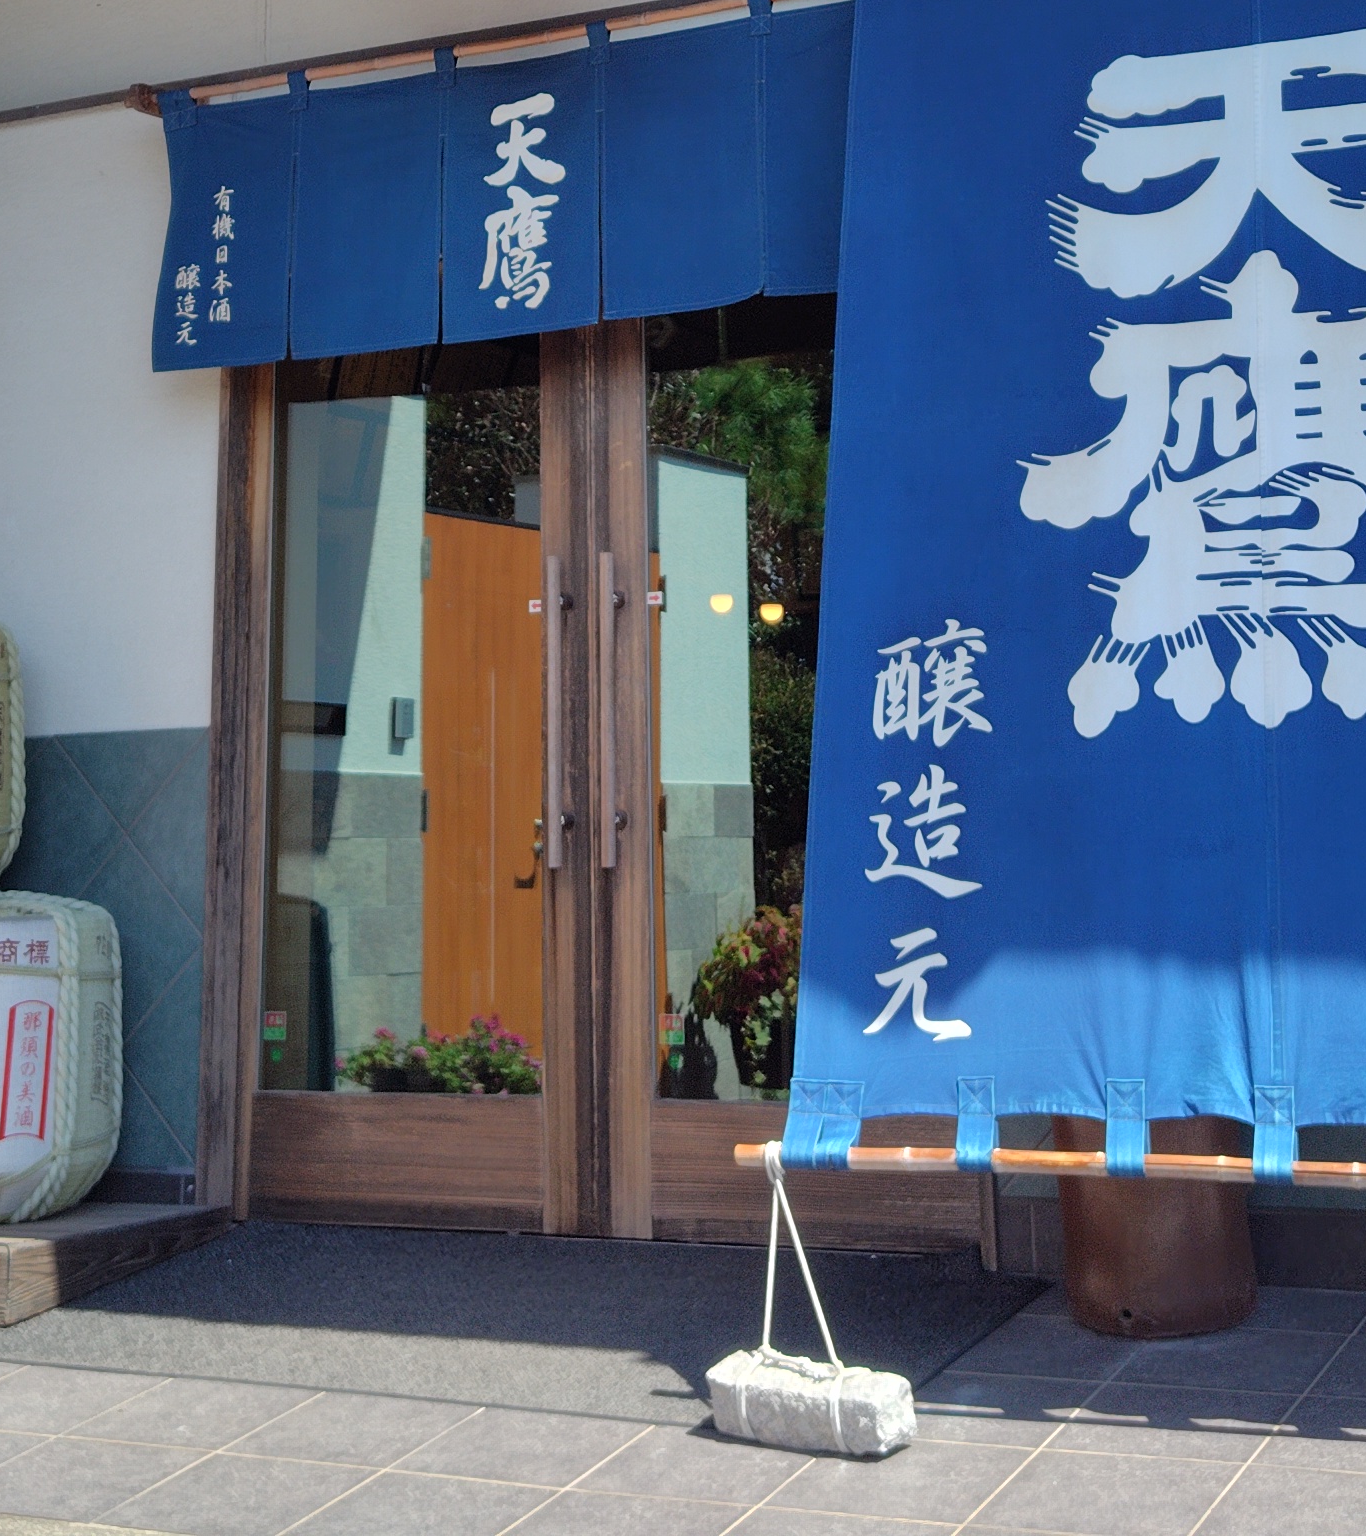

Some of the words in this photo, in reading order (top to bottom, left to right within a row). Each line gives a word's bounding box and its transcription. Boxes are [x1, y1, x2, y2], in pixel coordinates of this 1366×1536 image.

[208, 185, 235, 323] 有機日本酒
[478, 92, 566, 310] 天鷹
[13, 1011, 43, 1129] 那須の美酒
